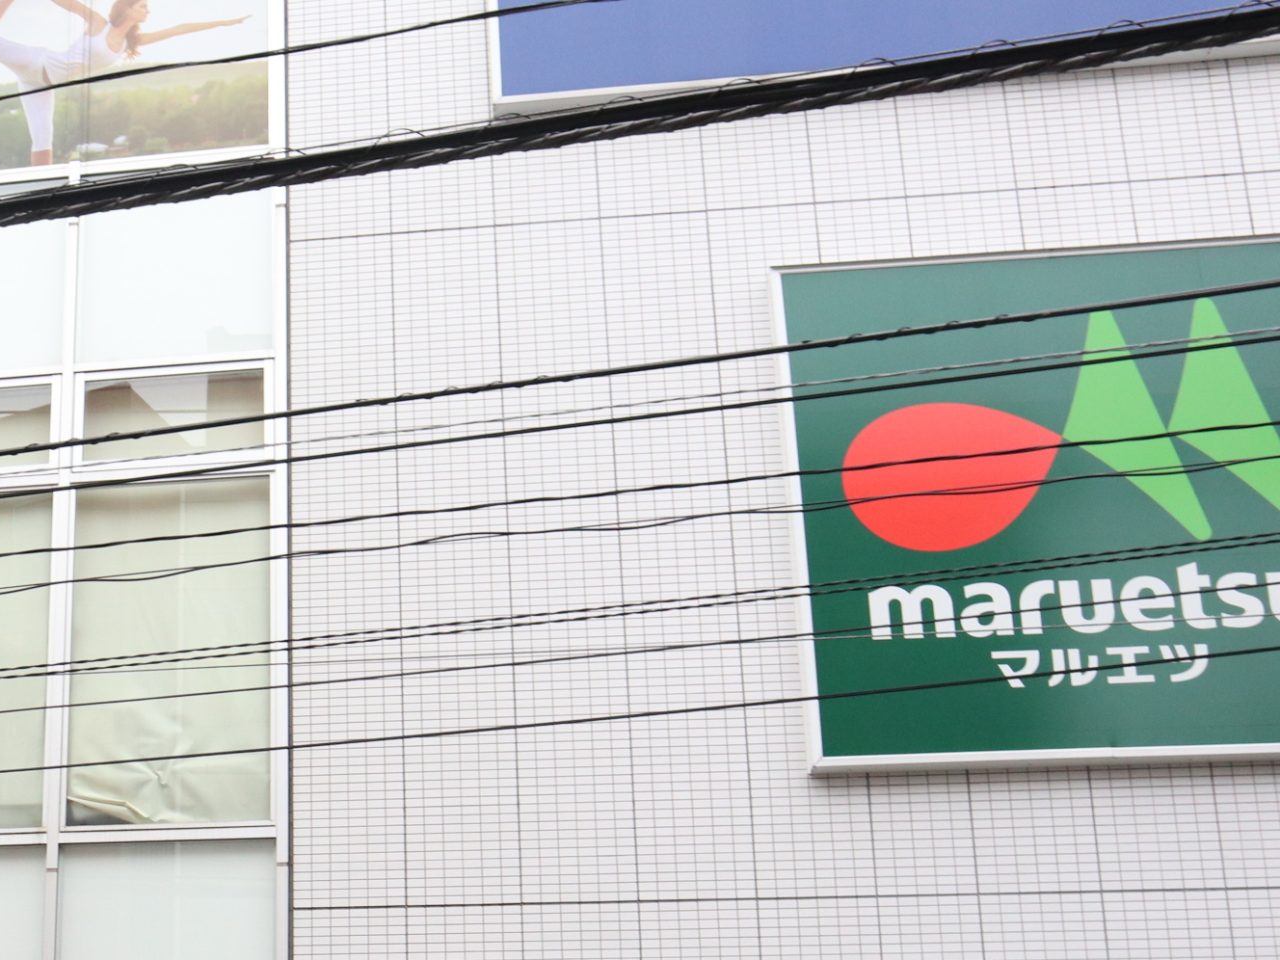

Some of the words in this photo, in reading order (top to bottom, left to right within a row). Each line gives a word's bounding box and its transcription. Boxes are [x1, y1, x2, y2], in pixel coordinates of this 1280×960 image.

[868, 561, 1280, 641] maruets
[990, 643, 1210, 689] マルエツ
